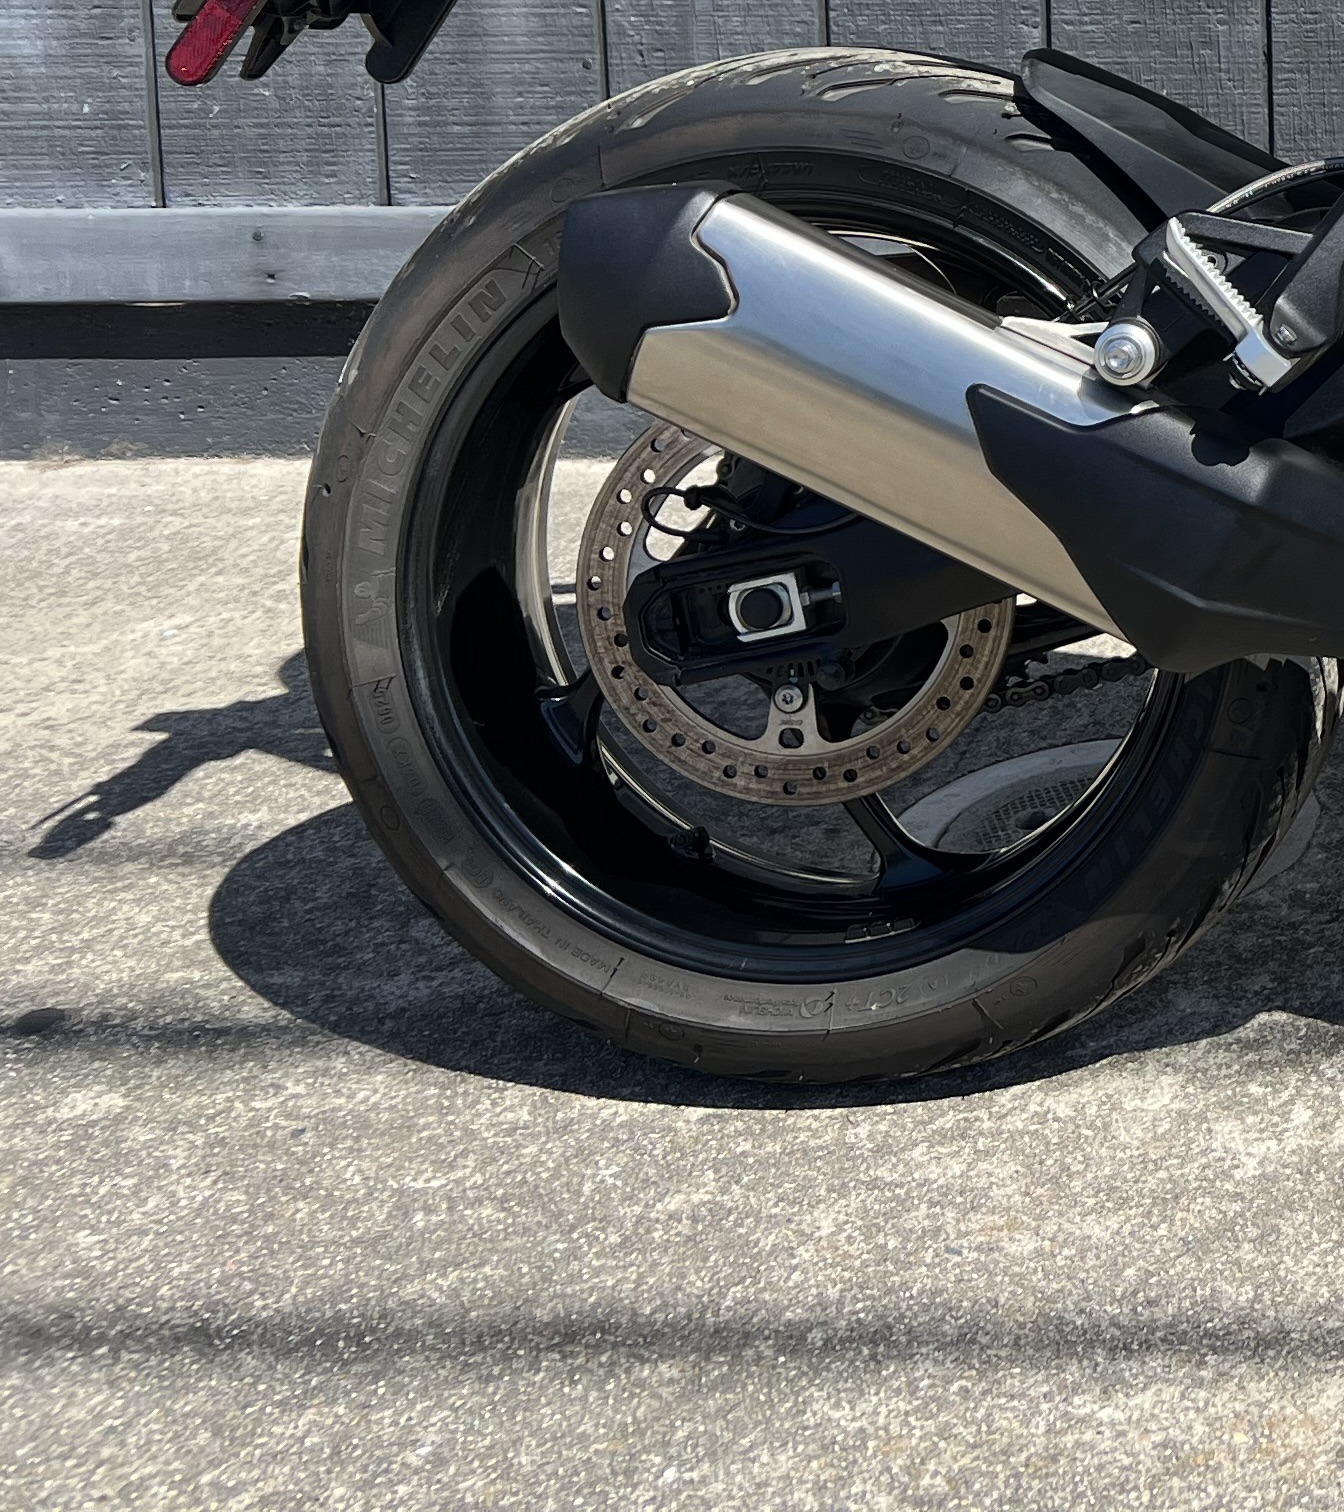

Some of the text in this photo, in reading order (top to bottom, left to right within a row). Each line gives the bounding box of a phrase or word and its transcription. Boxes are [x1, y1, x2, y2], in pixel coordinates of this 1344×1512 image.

[359, 277, 507, 556] MICHELIN
[554, 936, 572, 953] IN
[572, 945, 611, 974] MADE
